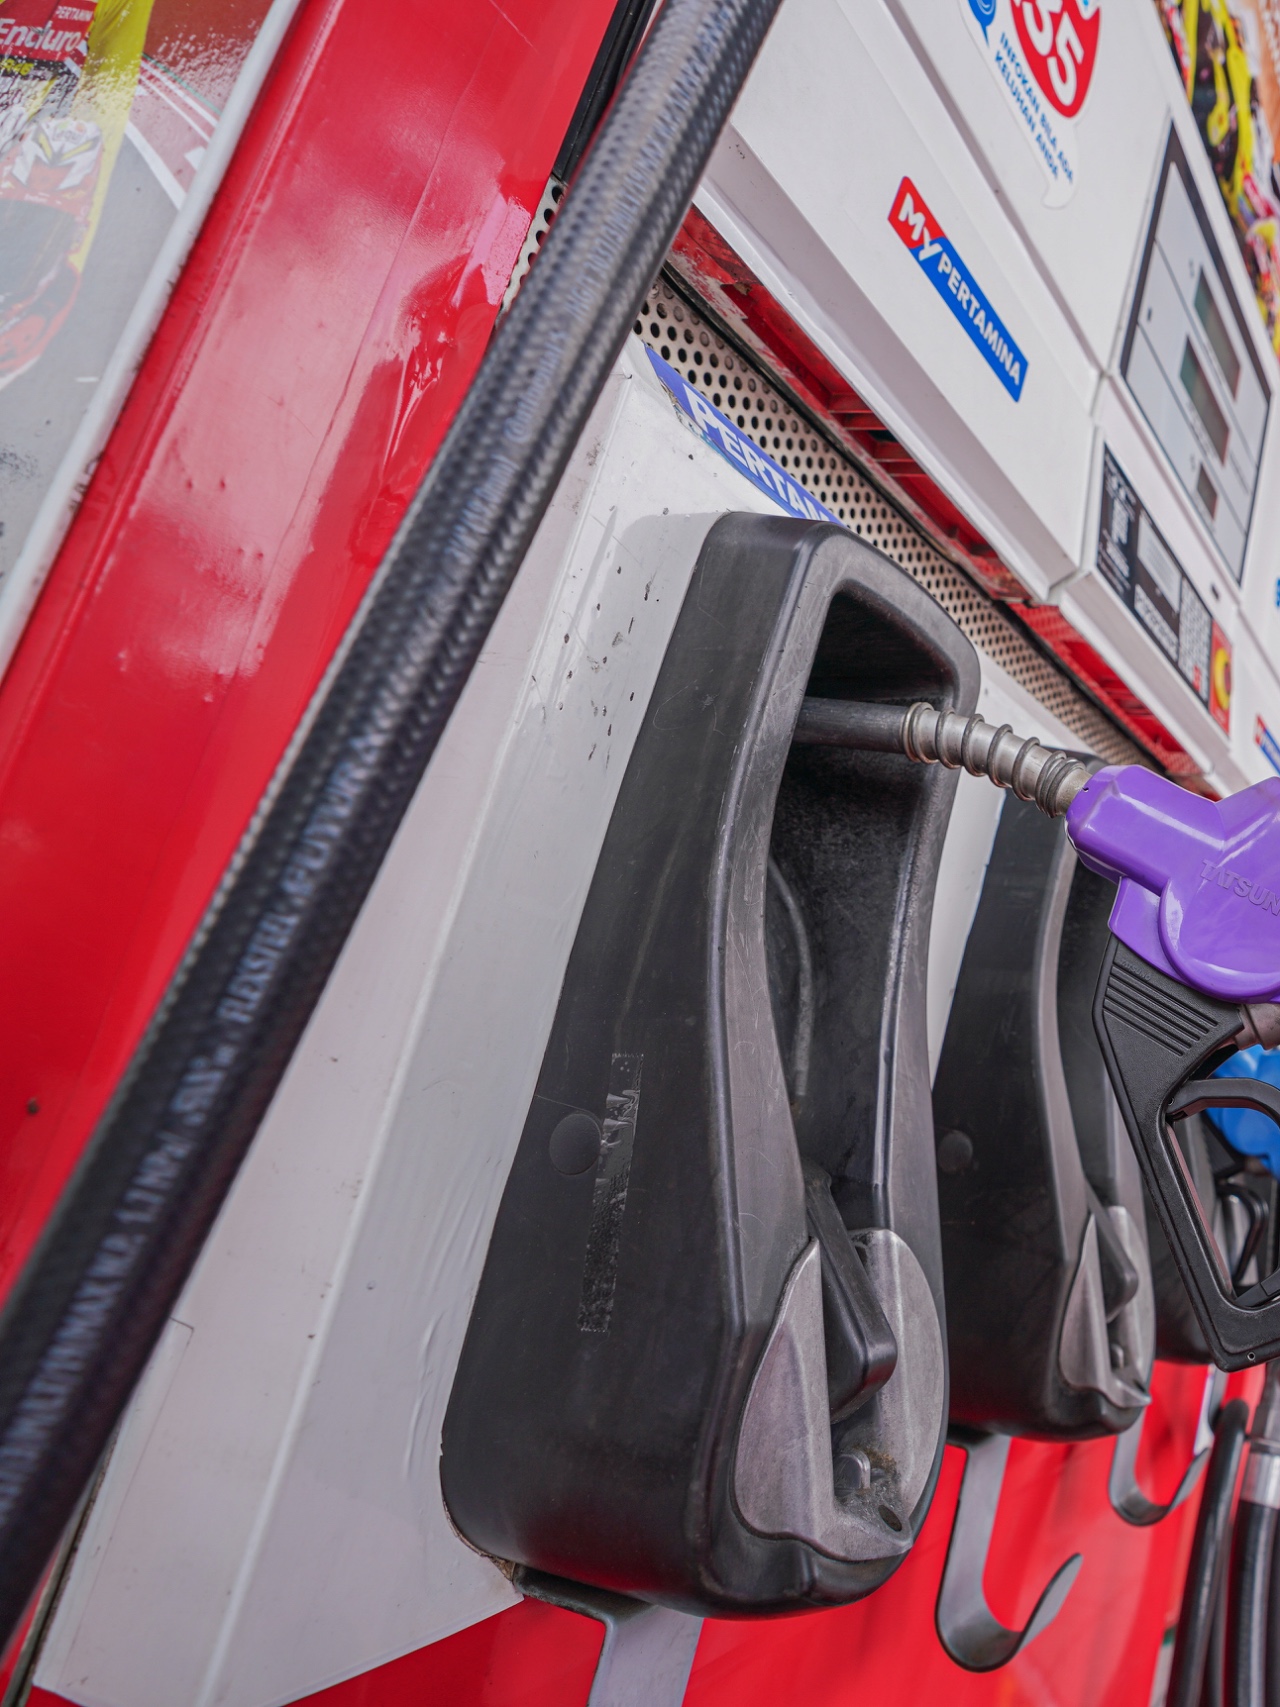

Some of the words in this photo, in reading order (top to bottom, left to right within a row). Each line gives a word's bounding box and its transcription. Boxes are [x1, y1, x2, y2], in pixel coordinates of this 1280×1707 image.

[0, 18, 81, 52] Enduro
[1000, 32, 1040, 114] INFOKAN
[1011, 0, 1085, 107] 35
[994, 50, 1036, 133] KELUHAN
[898, 191, 943, 261] MY
[937, 252, 1021, 385] PERTAMINA
